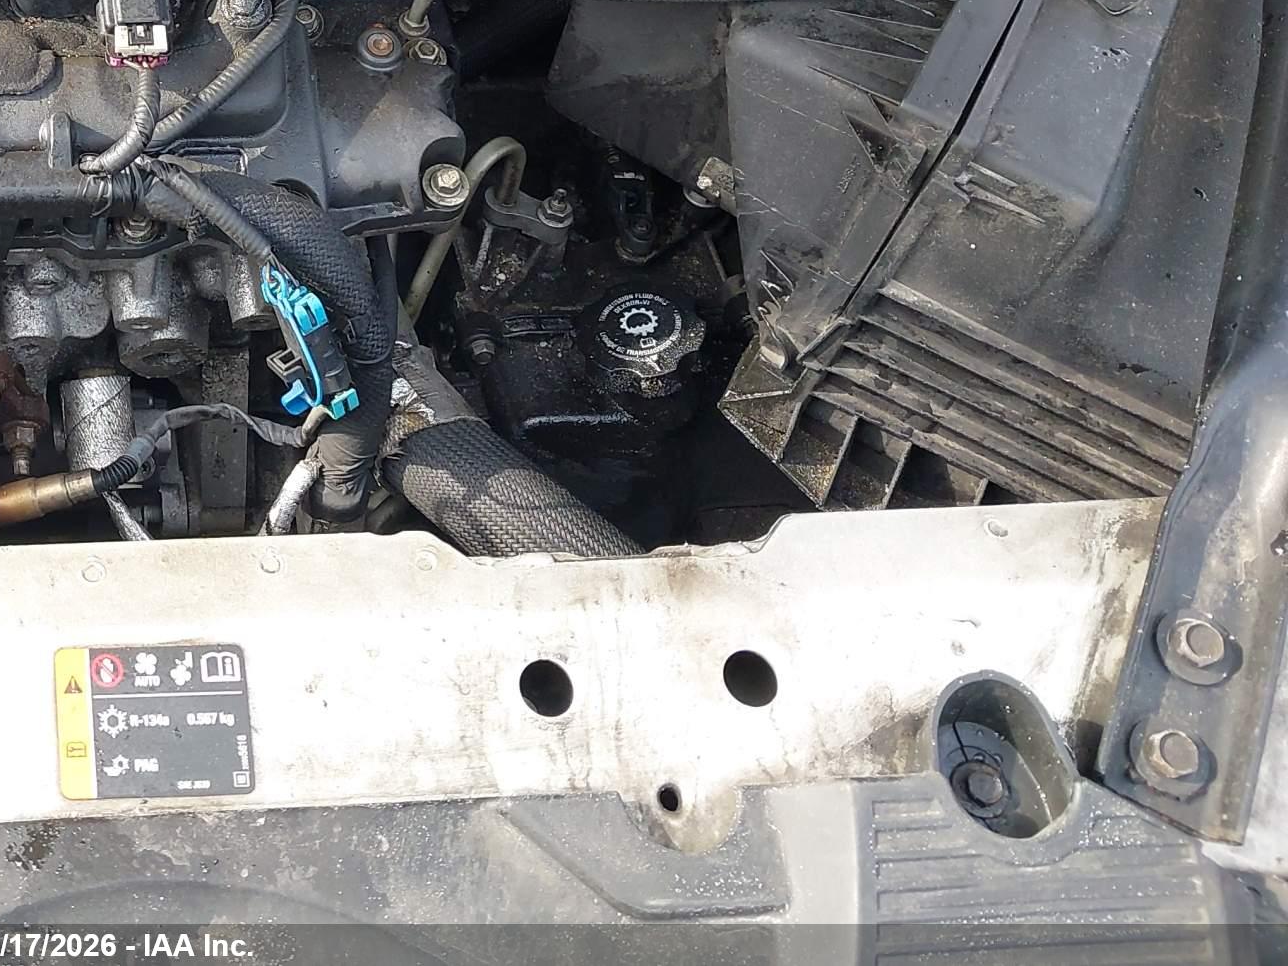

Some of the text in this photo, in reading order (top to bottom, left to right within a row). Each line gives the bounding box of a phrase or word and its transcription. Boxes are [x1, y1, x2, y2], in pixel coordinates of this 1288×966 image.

[134, 675, 161, 687] AUTO
[129, 714, 171, 727] R-134a
[218, 711, 235, 727] kg
[134, 758, 160, 773] PAG
